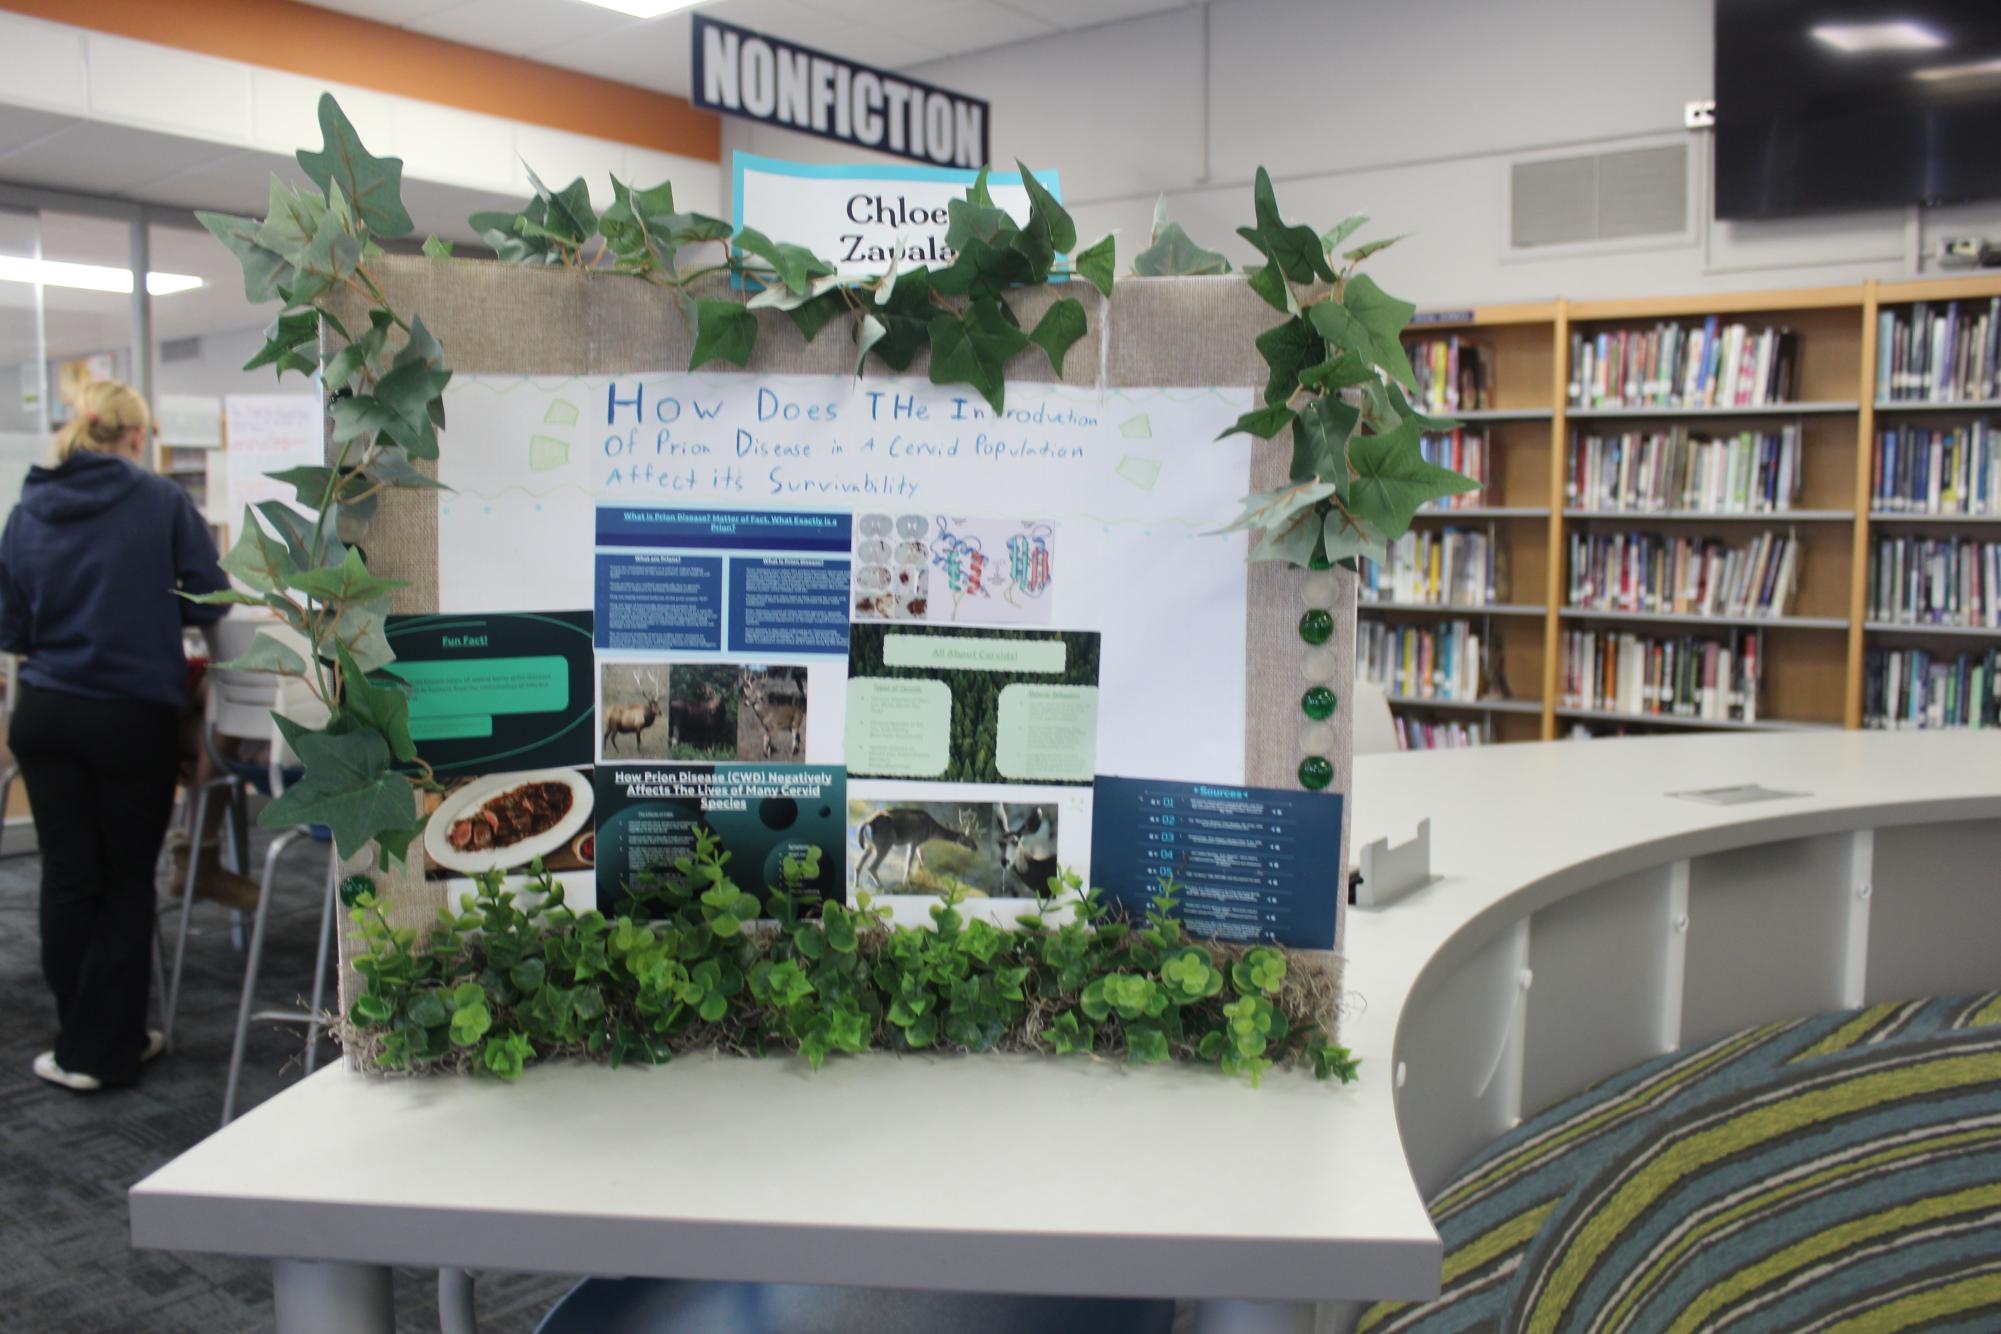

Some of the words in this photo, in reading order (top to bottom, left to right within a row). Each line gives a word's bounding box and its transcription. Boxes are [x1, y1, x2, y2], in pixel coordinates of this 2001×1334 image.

[703, 26, 983, 168] NONFICTION
[846, 194, 948, 228] Chloe
[606, 382, 725, 426] How
[757, 387, 839, 421] Does
[605, 427, 638, 456] Of
[657, 428, 711, 456] Prion
[737, 428, 811, 457] Disease
[832, 440, 843, 454] in
[890, 435, 960, 457] Cervid
[976, 434, 1085, 460] Population
[606, 466, 696, 490] Affect
[714, 469, 744, 490] its
[769, 465, 920, 499] Survivability
[442, 635, 461, 647] Fun
[463, 634, 488, 647] Fact!
[615, 771, 642, 784] How
[645, 771, 678, 785] Prion
[680, 772, 725, 785] Disease
[727, 771, 766, 785] (CWD)
[768, 771, 832, 786] Negatively
[626, 785, 671, 798] Affects
[673, 785, 696, 797] The
[698, 785, 728, 797] Lives
[731, 785, 744, 797] of
[746, 786, 779, 799] Many
[781, 785, 821, 798] Cervid
[700, 798, 747, 810] Species
[1199, 785, 1243, 799] Sources
